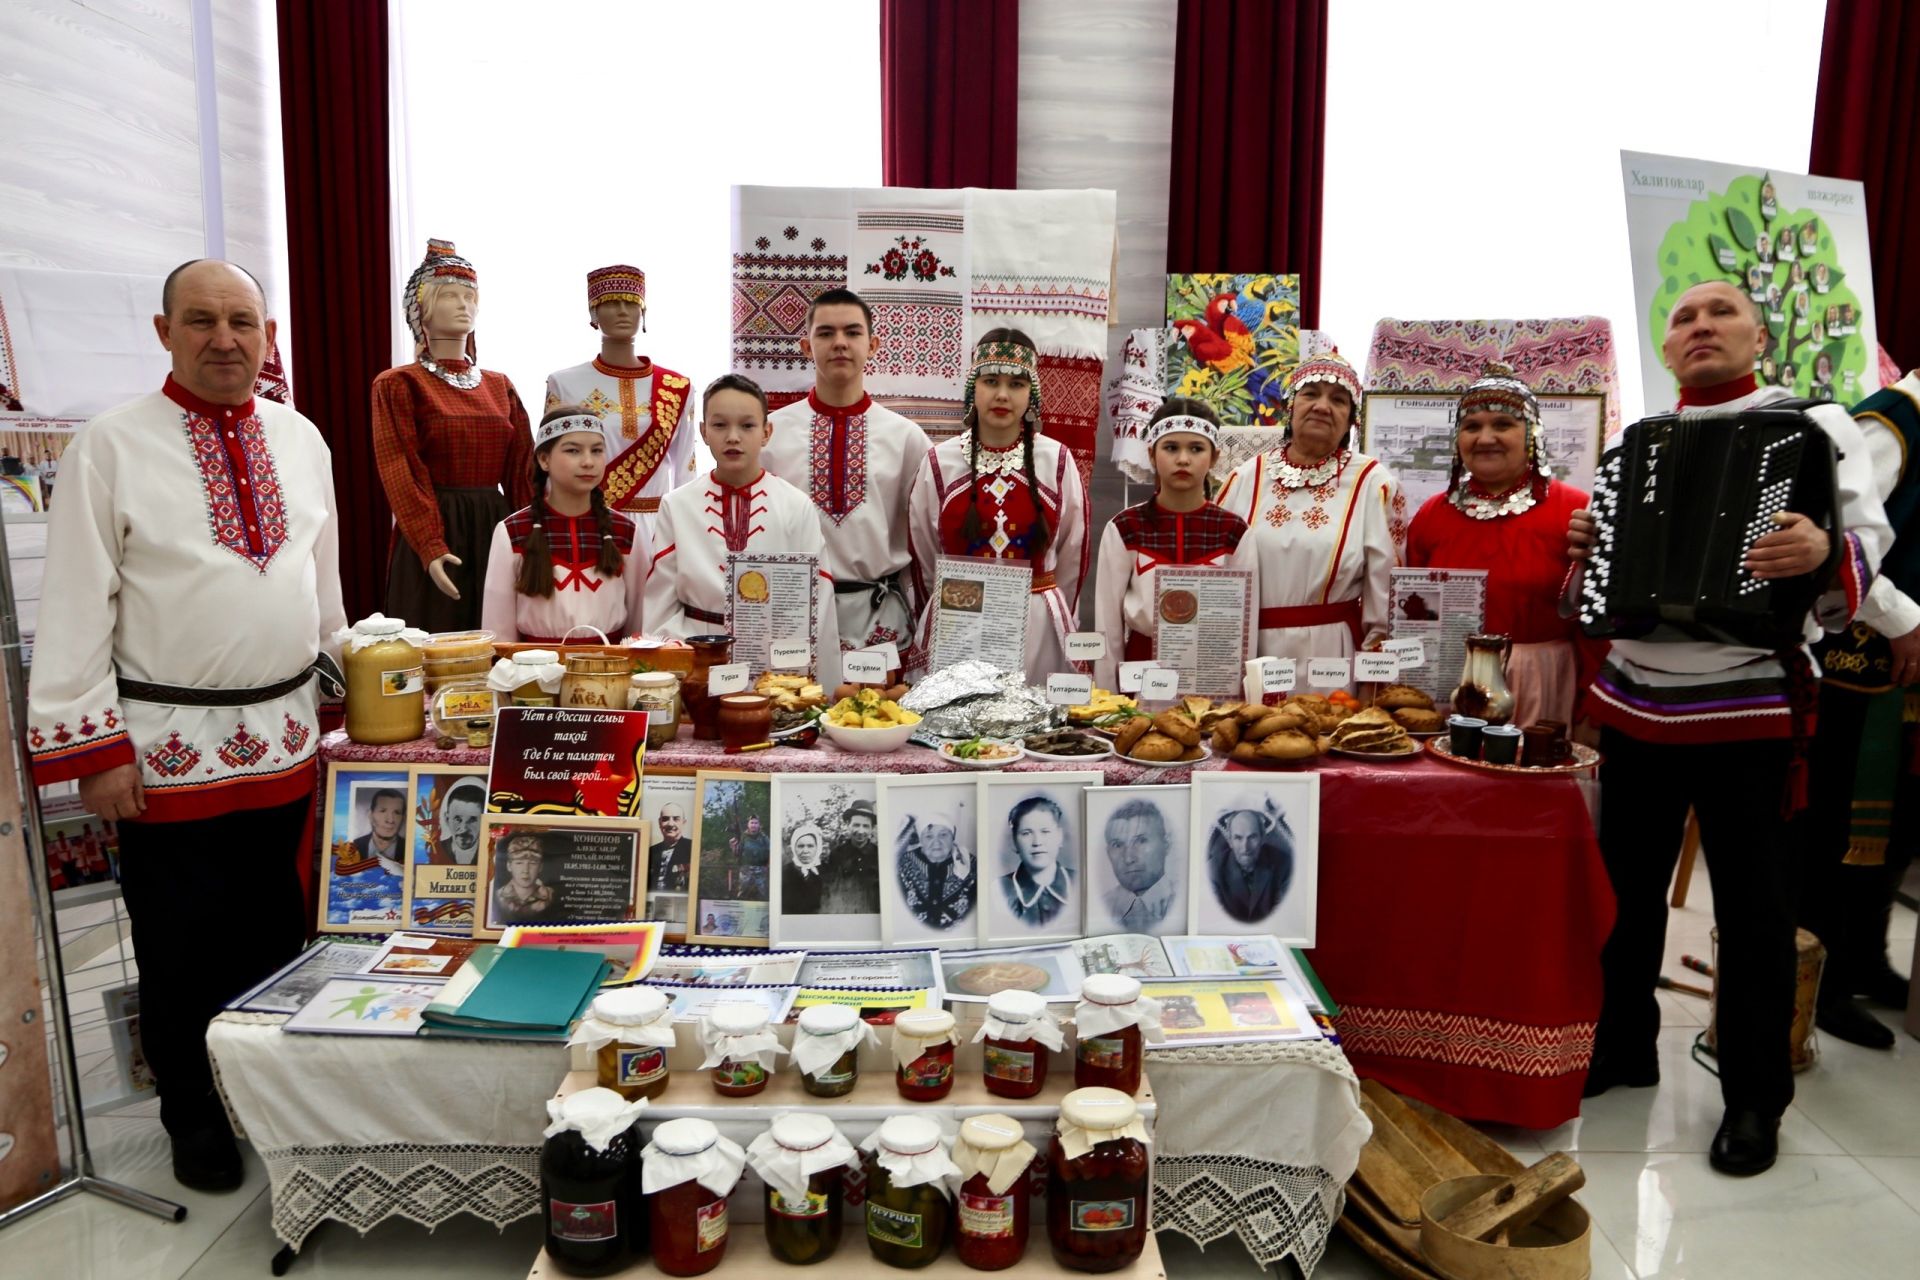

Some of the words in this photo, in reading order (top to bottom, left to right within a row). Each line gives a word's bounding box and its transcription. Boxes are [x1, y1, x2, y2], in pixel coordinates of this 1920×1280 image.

[1630, 170, 1705, 192] Халитовлар
[1643, 443, 1662, 503] ТУЛА
[569, 691, 608, 707] МЁД
[521, 709, 544, 722] Нет
[547, 712, 553, 721] в
[555, 711, 591, 723] России
[594, 713, 625, 723] семьи
[554, 731, 587, 743] такой
[523, 747, 540, 760] Где
[544, 747, 552, 760] б
[553, 751, 563, 760] не
[567, 751, 615, 762] памятен
[524, 767, 544, 779] был
[547, 769, 569, 781] свой
[572, 770, 609, 784] герой...
[573, 834, 621, 844] КОНОНОВ
[445, 868, 477, 880] Конон
[429, 881, 467, 893] Михаил
[871, 1205, 916, 1223] ОГУРЦЫ
